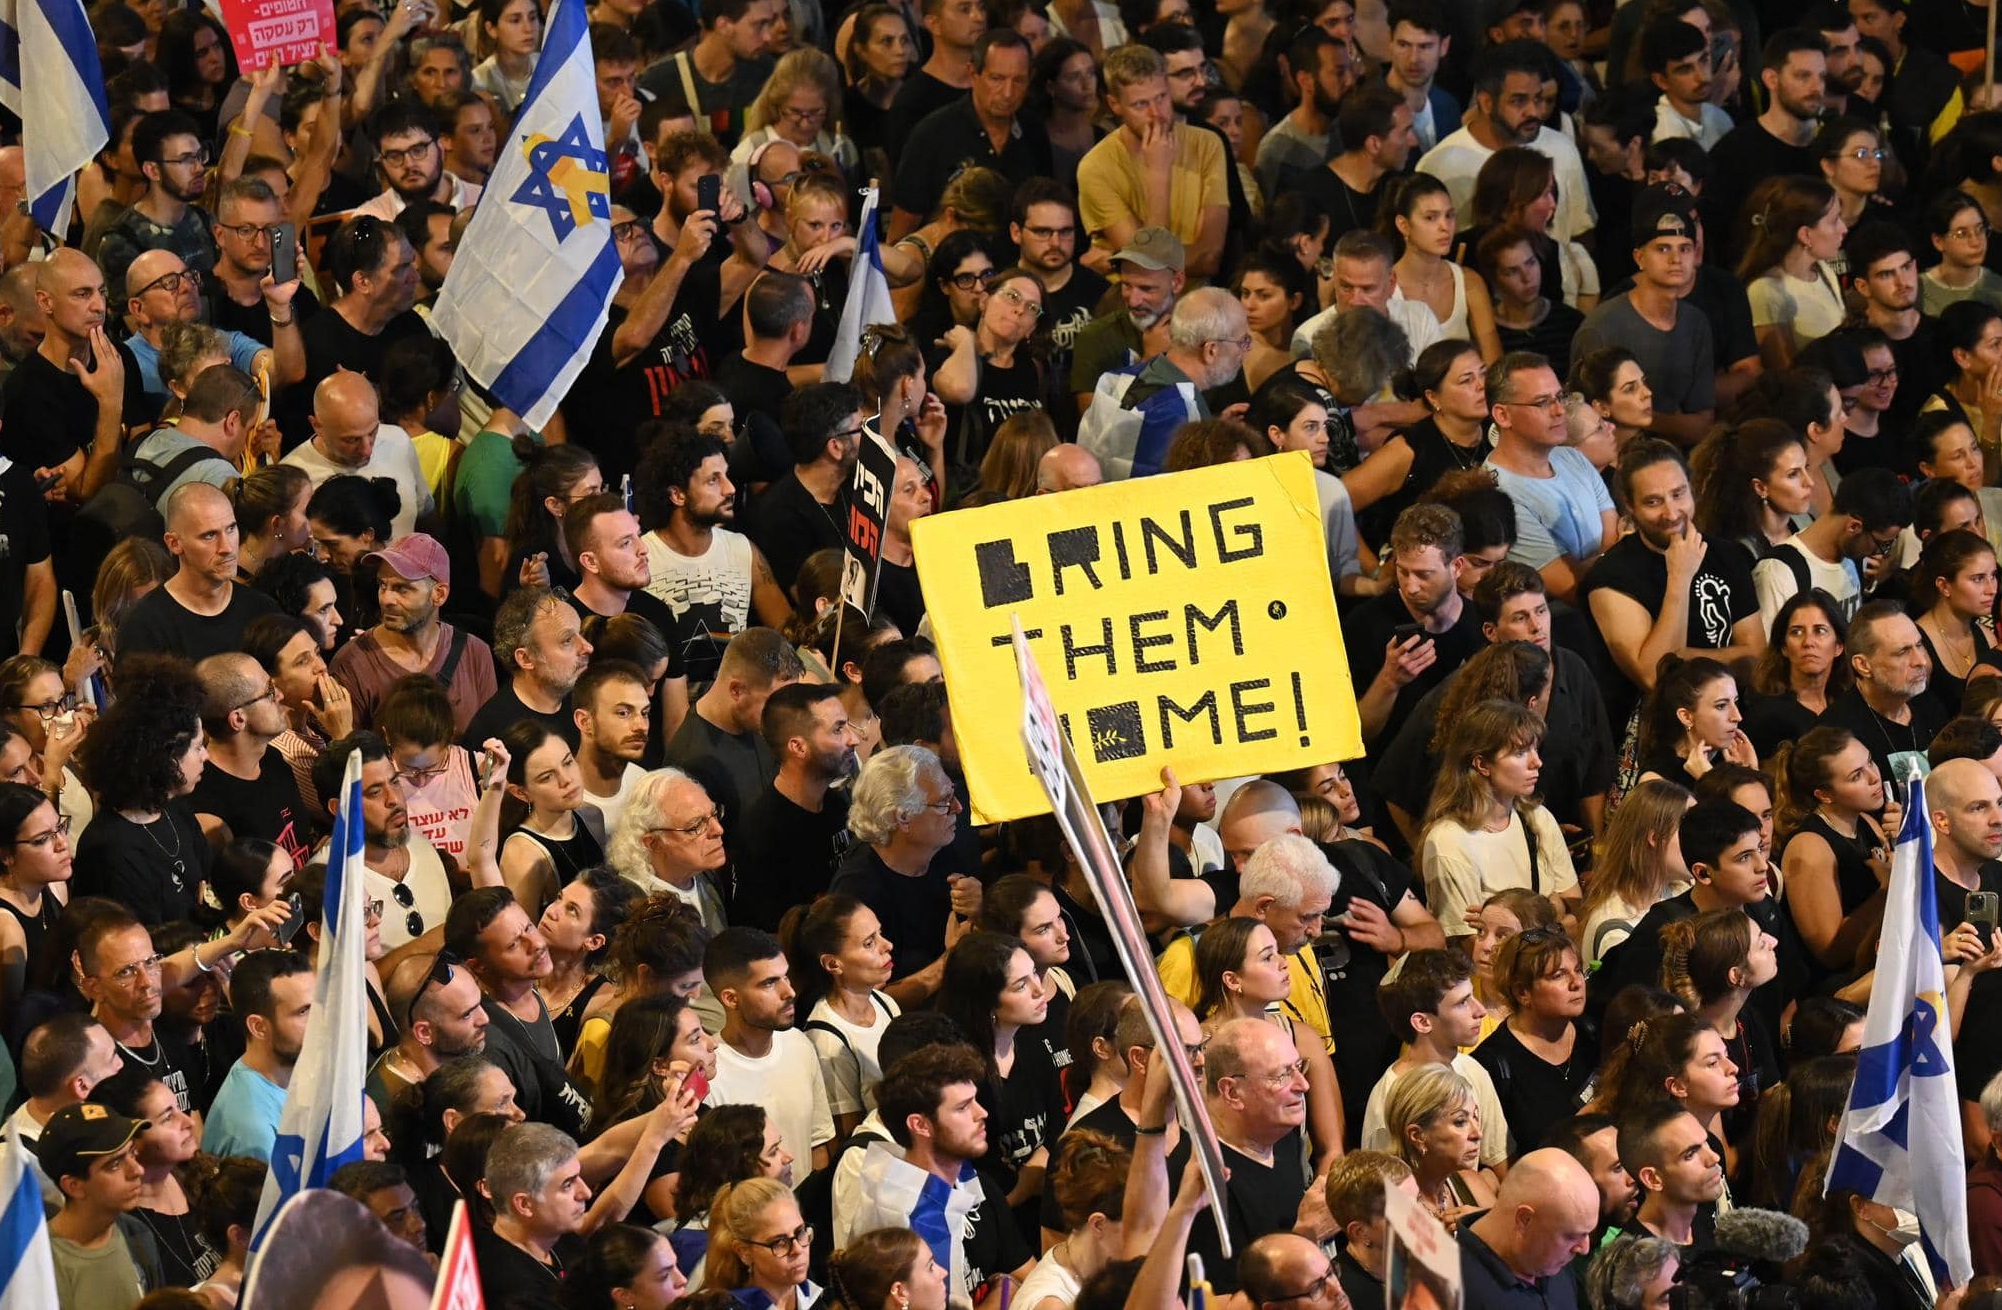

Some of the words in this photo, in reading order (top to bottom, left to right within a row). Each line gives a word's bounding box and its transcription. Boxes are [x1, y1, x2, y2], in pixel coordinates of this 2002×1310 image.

[253, 22, 294, 41] עסקה
[297, 17, 317, 36] רק
[975, 497, 1264, 609] BRING
[448, 808, 469, 821] לא
[422, 827, 446, 840] עד
